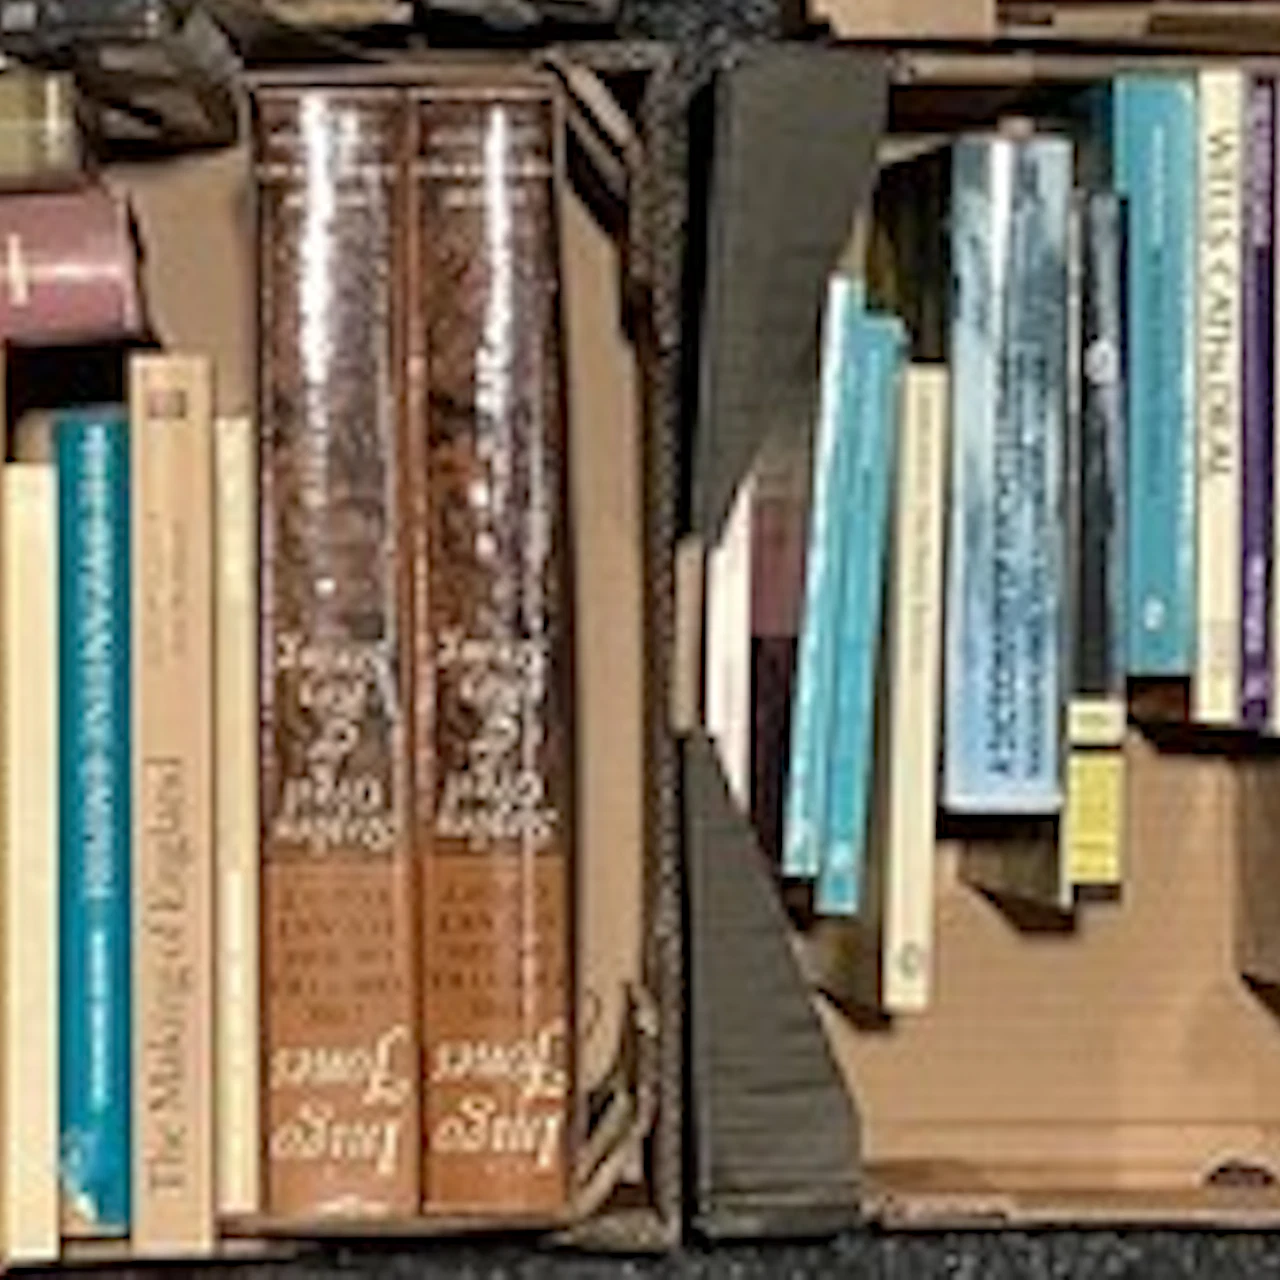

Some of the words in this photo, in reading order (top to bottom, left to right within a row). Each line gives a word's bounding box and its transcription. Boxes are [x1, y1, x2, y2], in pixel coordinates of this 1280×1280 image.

[1204, 128, 1234, 257] WELLS
[1203, 265, 1234, 477] CATHEDRAL
[142, 756, 191, 913] England
[144, 920, 186, 957] of
[146, 965, 196, 1110] Making
[147, 1125, 187, 1197] The
